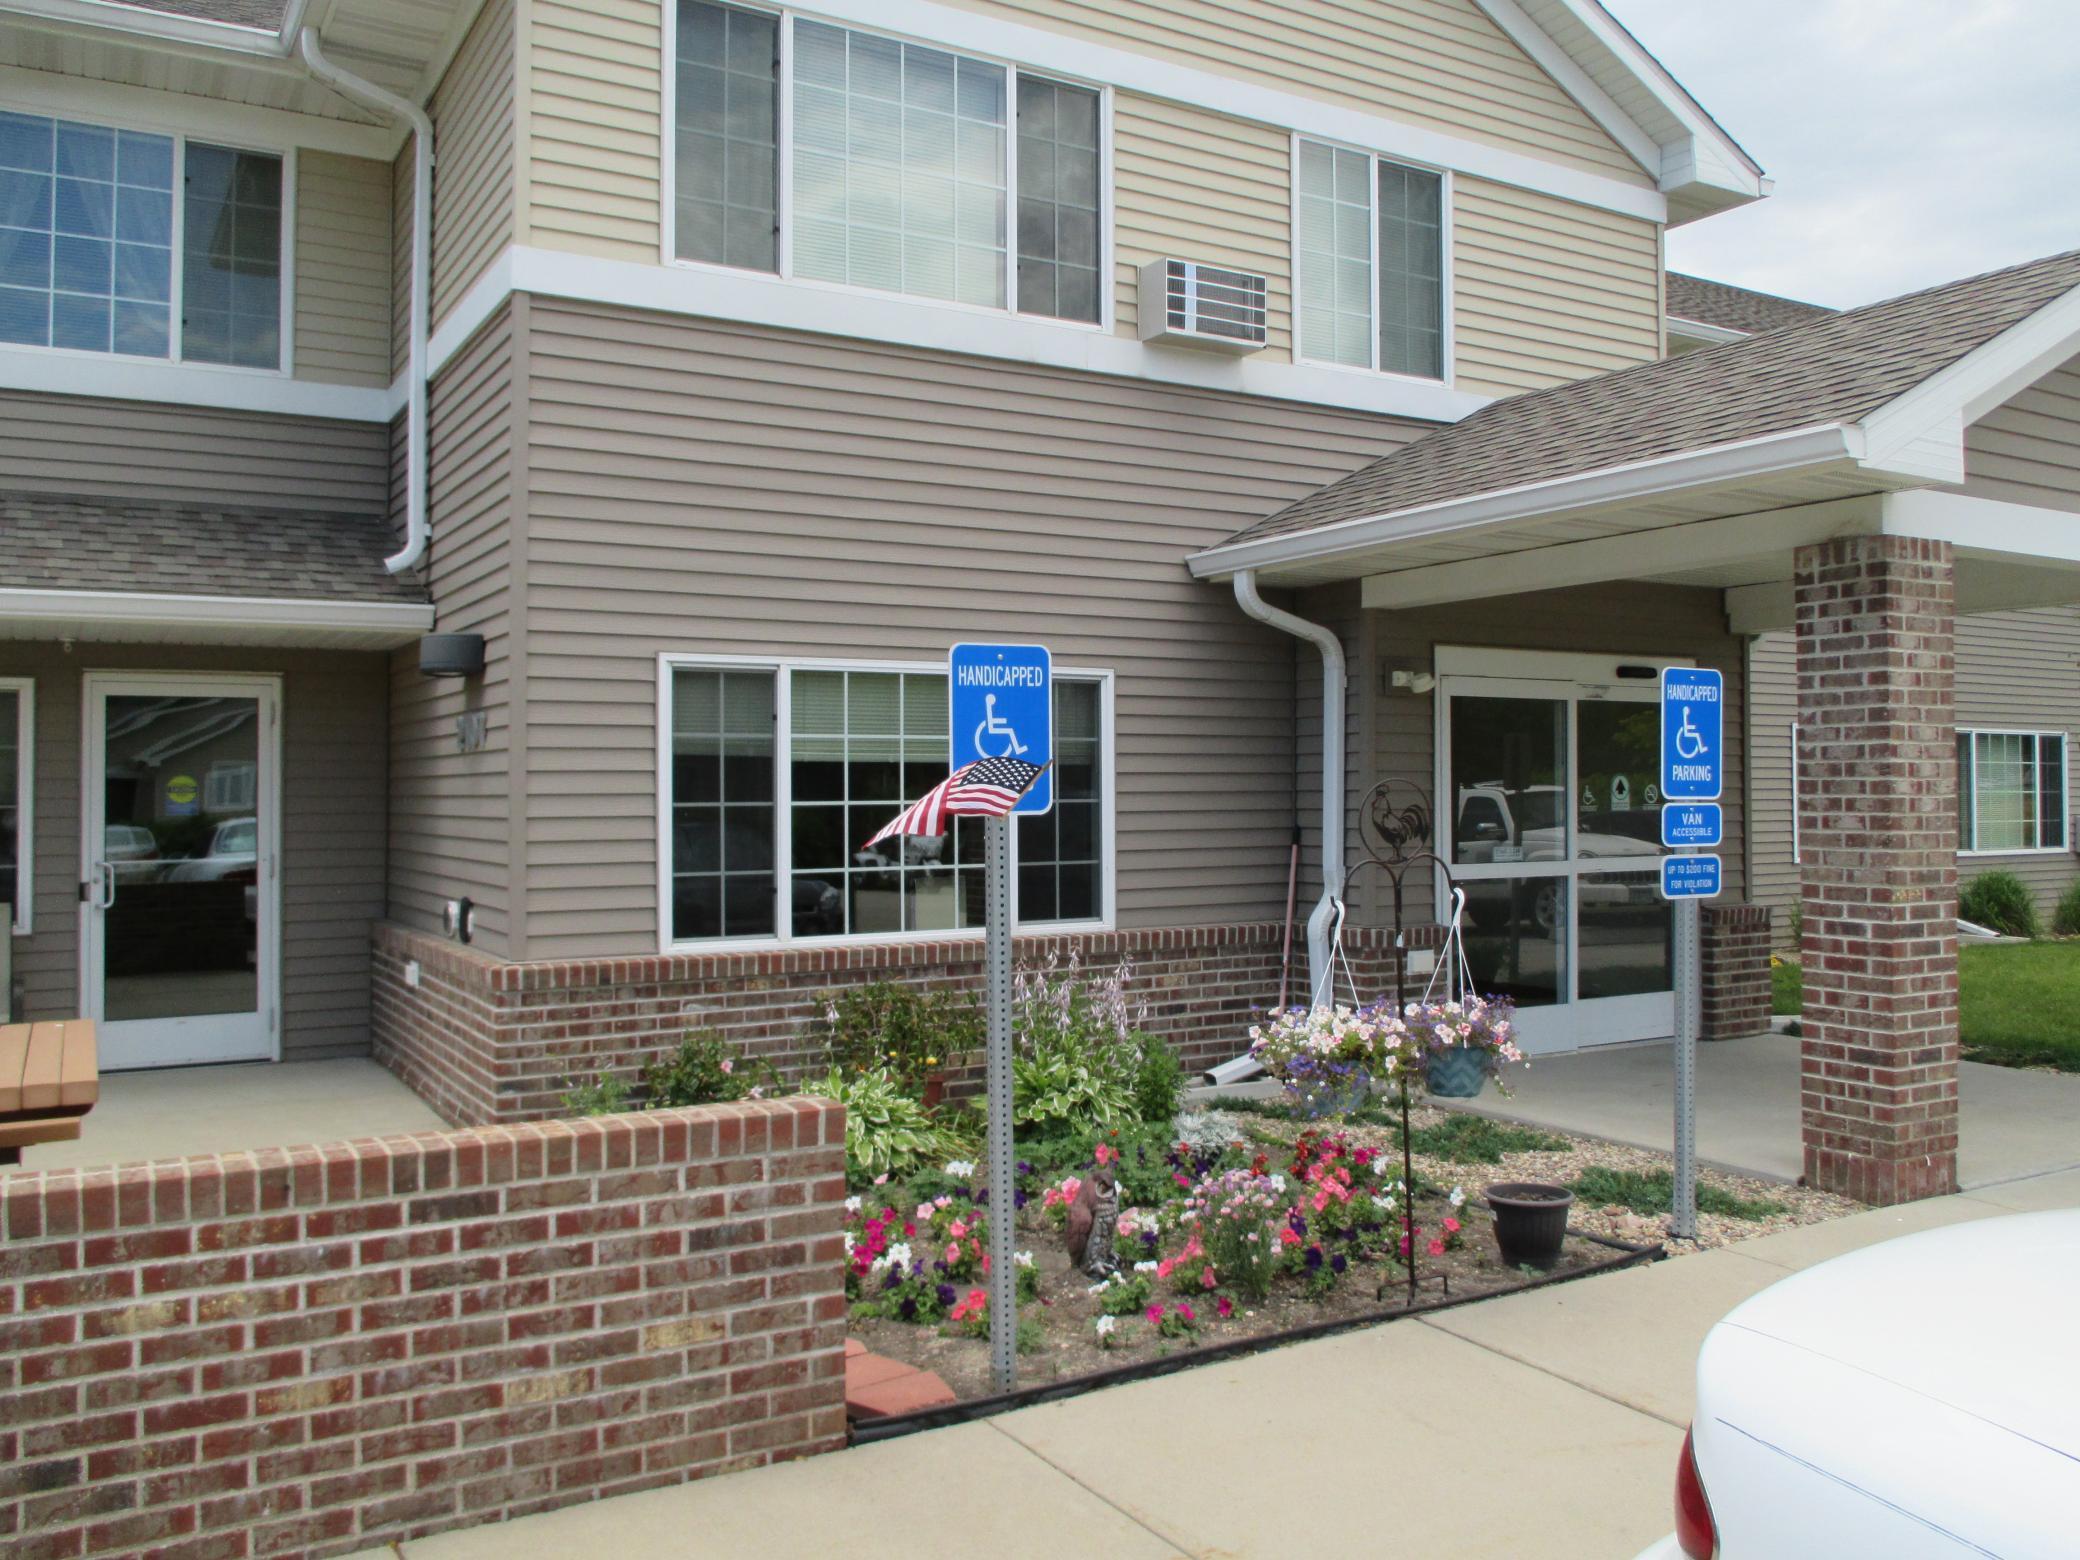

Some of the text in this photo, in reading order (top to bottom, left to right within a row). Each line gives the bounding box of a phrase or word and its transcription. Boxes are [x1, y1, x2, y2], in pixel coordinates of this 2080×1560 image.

[958, 664, 1043, 687] HANDICAPPED
[1667, 684, 1718, 702] HANDICAPPED
[1672, 765, 1712, 781] PARKING
[1682, 812, 1702, 826] VAN
[1672, 827, 1713, 836] ACCESSIBLE
[1667, 865, 1676, 875] UP
[1677, 865, 1685, 874] TO
[1703, 864, 1716, 873] FINE
[1670, 879, 1712, 889] FOR VIOLATION
